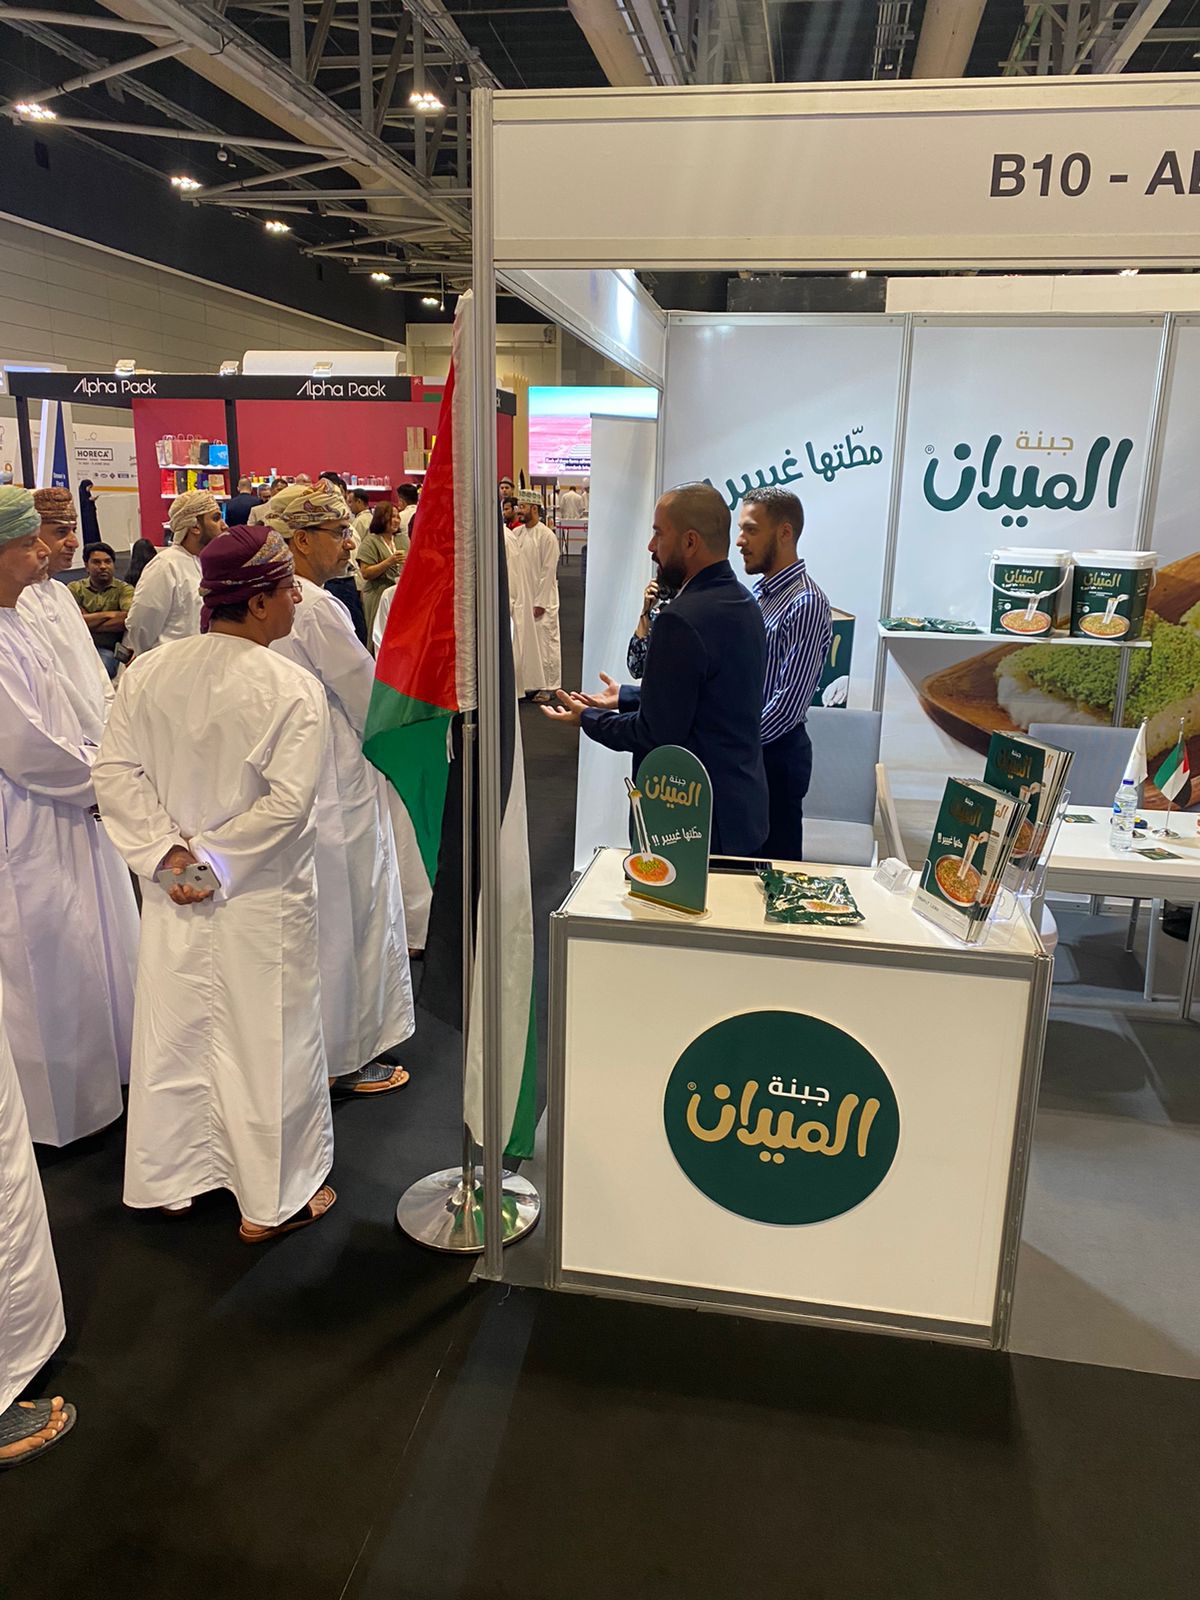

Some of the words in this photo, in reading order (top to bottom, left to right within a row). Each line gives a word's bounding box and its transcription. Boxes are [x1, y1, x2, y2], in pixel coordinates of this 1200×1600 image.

[990, 152, 1091, 197] B10
[1109, 174, 1128, 183] -
[73, 377, 118, 397] Alpha
[121, 378, 157, 394] Pack
[297, 379, 343, 399] Alpha
[348, 380, 386, 397] Pack
[77, 450, 110, 458] HORECA
[1016, 431, 1074, 456] جبنة
[923, 434, 1134, 528] الميدان
[645, 774, 702, 808] الميدان
[670, 775, 687, 786] جبنة
[768, 1075, 830, 1107] جبنة
[686, 1080, 881, 1164] الميدان
